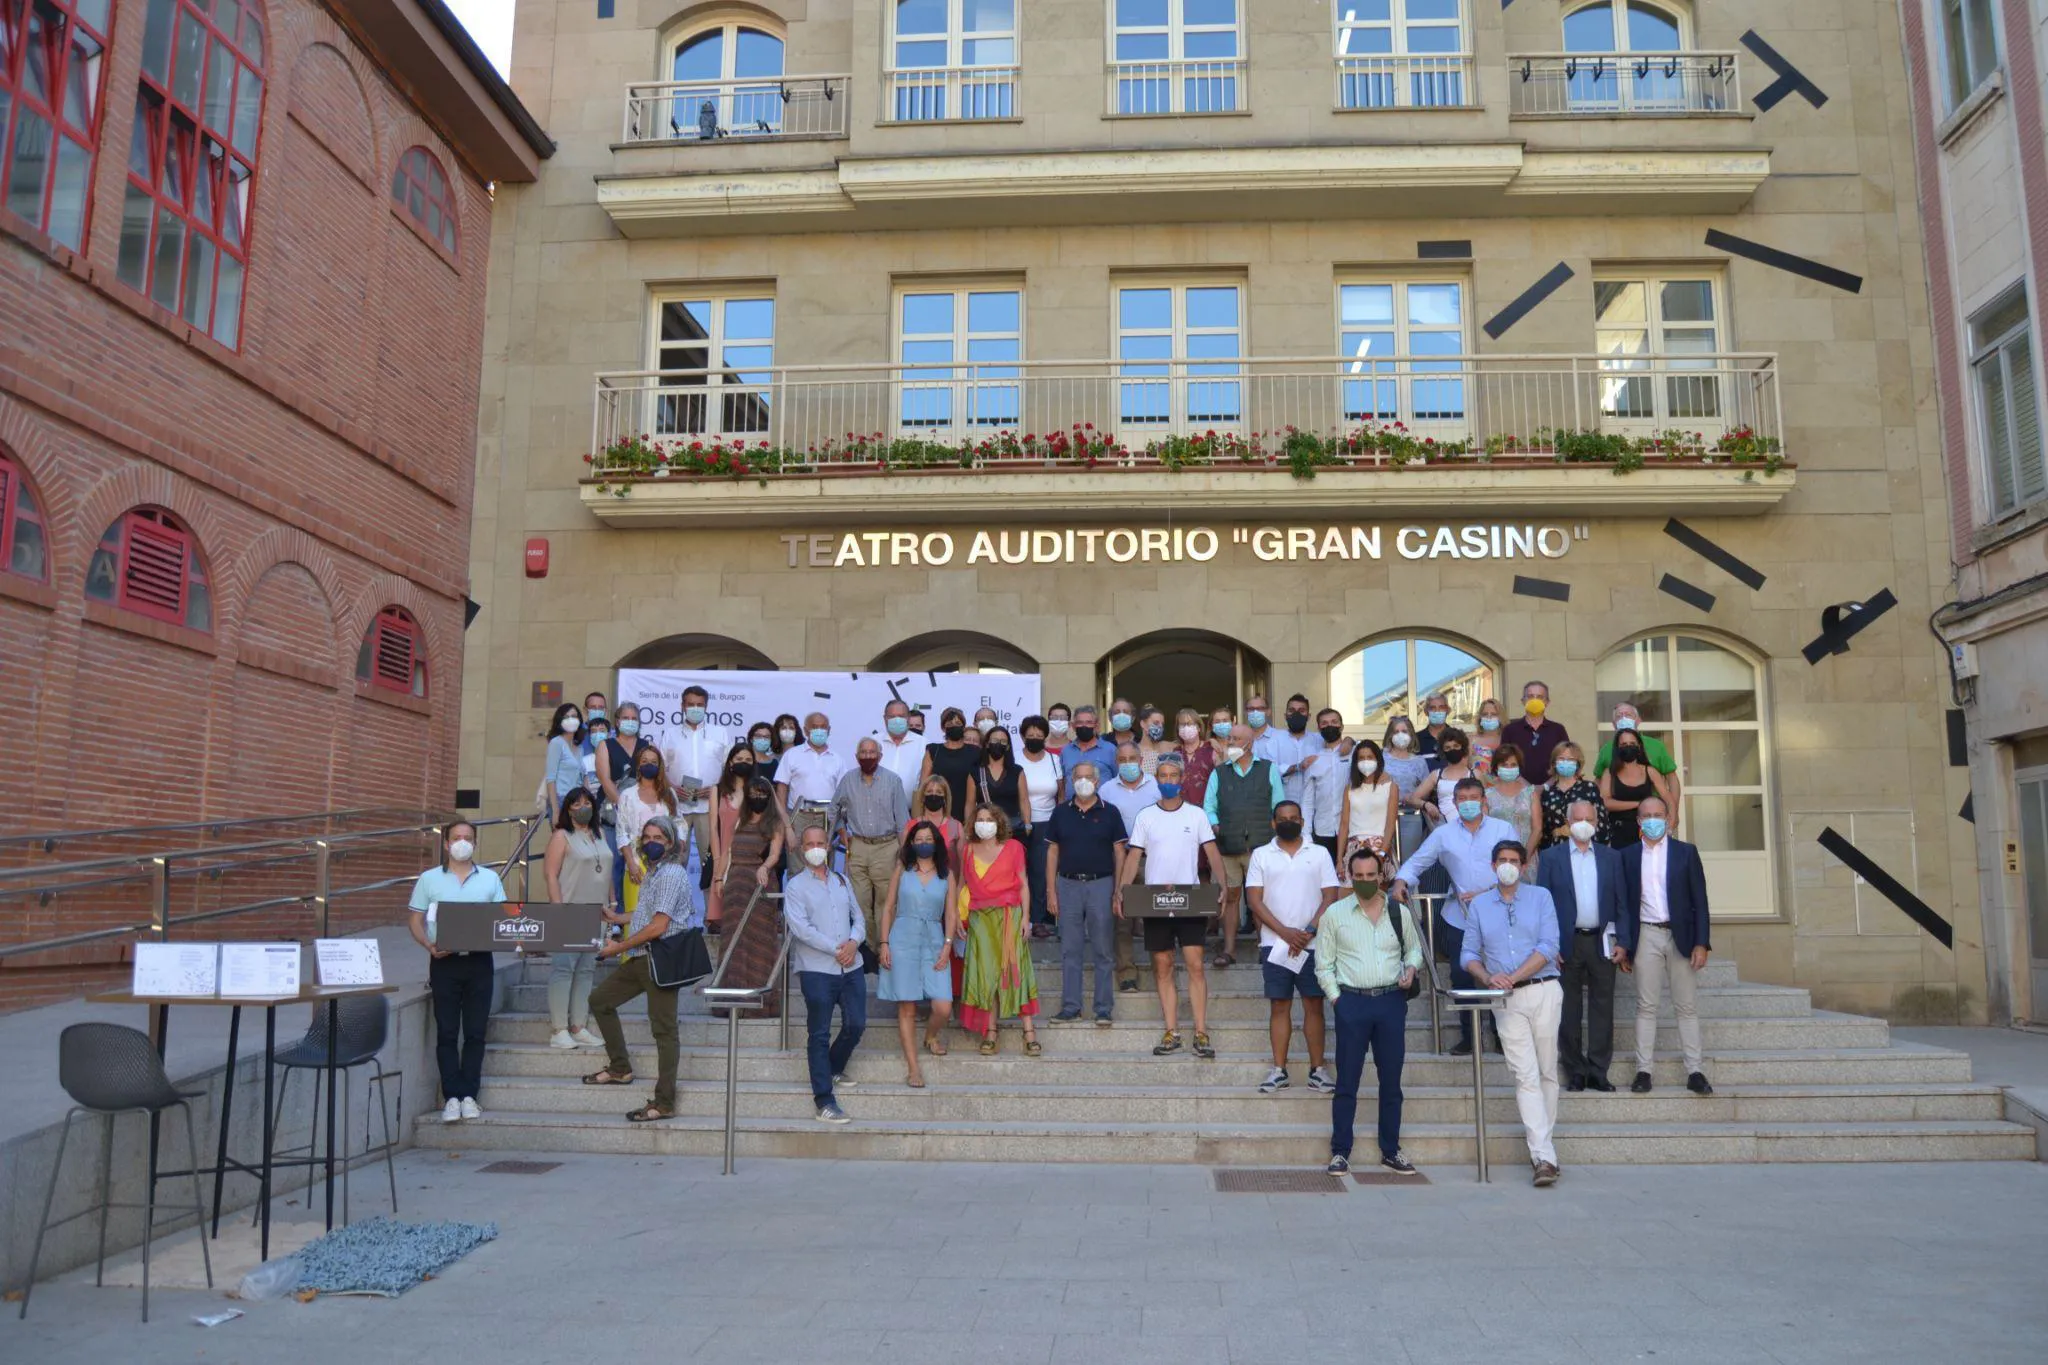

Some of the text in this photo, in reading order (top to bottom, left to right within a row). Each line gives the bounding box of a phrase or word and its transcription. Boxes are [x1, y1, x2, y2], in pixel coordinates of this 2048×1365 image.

[780, 525, 1589, 567] TEATRO AUDITORIO "GRAN CASINO"
[661, 691, 671, 699] de
[719, 693, 746, 702] Burgos
[980, 696, 991, 707] El
[639, 706, 743, 726] Os dmos
[499, 924, 539, 932] PELAYO
